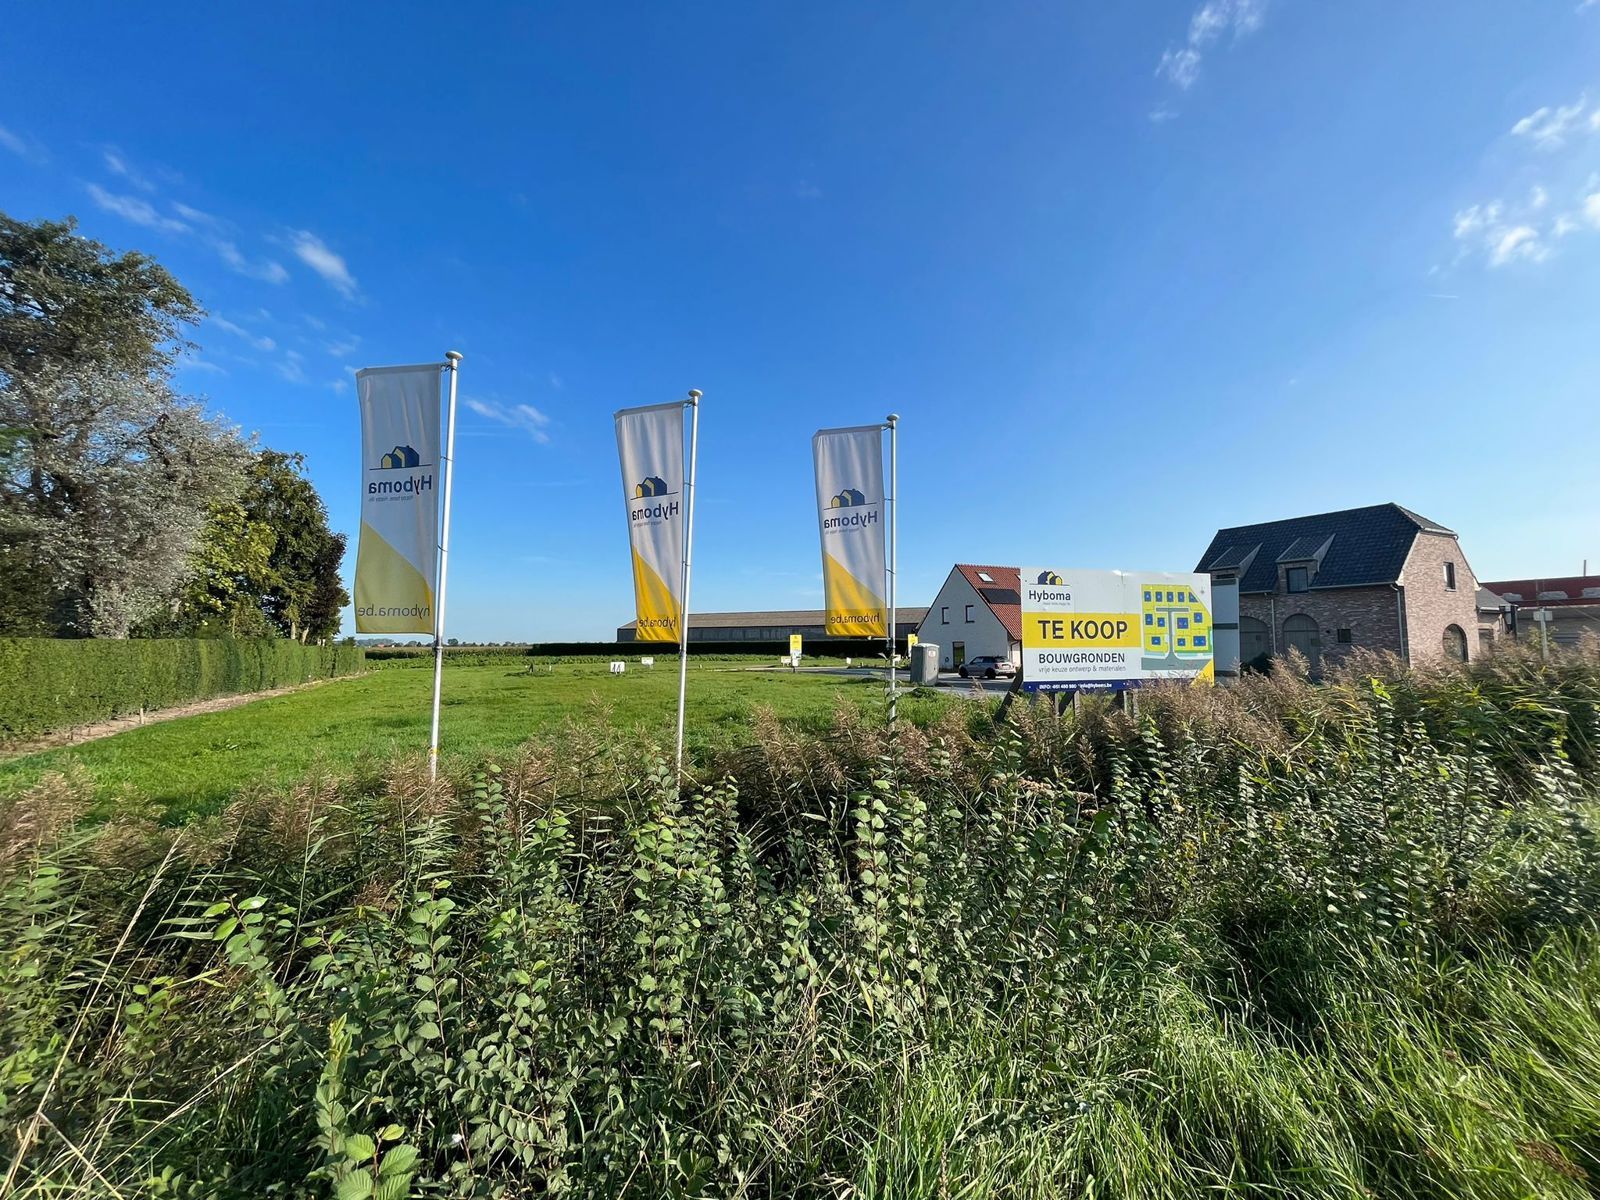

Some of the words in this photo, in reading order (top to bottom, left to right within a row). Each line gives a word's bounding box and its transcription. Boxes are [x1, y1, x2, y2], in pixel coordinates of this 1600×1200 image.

[1028, 590, 1071, 602] Hyboma
[1038, 620, 1064, 639] TE
[1071, 620, 1128, 639] KOOP
[1039, 653, 1125, 664] BOUWGRONDEN
[1039, 665, 1050, 673] vrije
[1069, 665, 1091, 673] ontwerp
[1098, 664, 1126, 672] materialen
